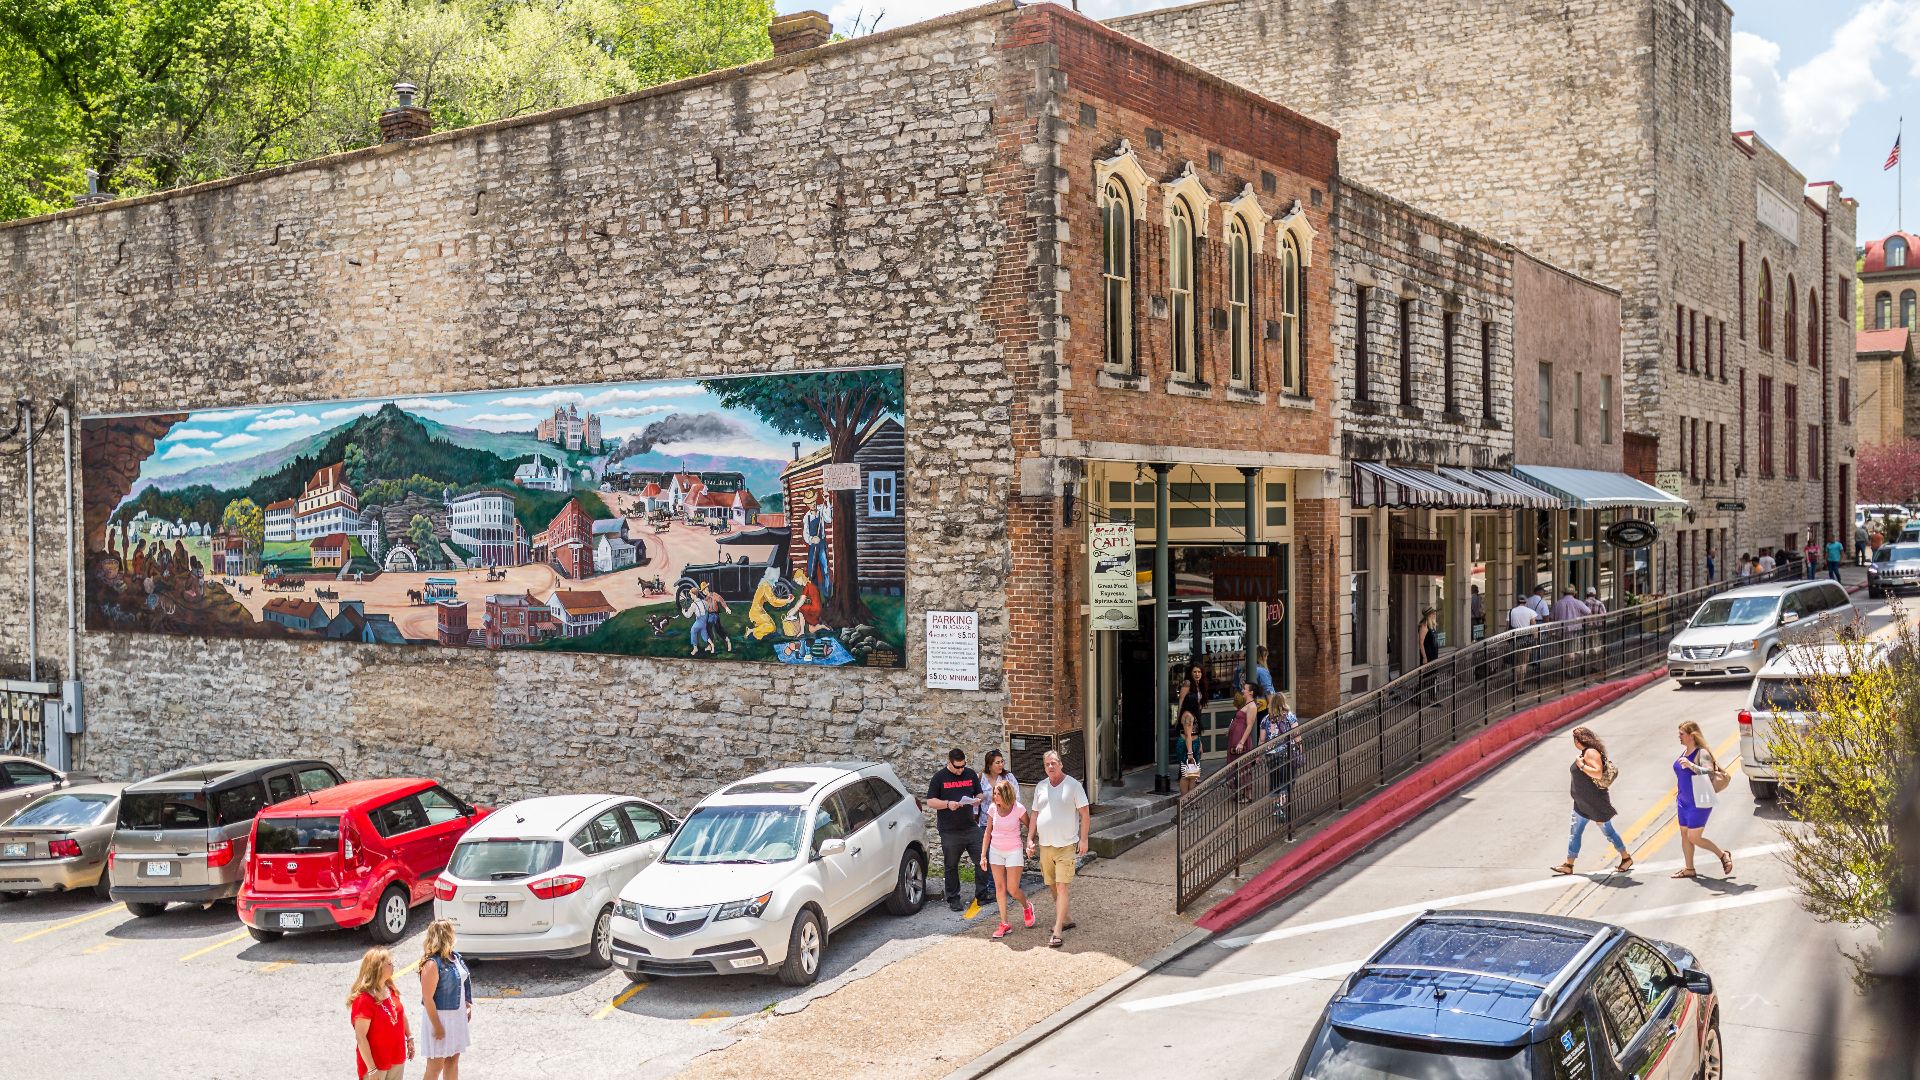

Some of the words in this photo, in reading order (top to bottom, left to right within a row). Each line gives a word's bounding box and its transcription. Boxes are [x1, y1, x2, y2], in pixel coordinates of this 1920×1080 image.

[1400, 553, 1444, 572] STONE
[932, 615, 973, 625] PARKING
[949, 674, 977, 682] MINIMUM
